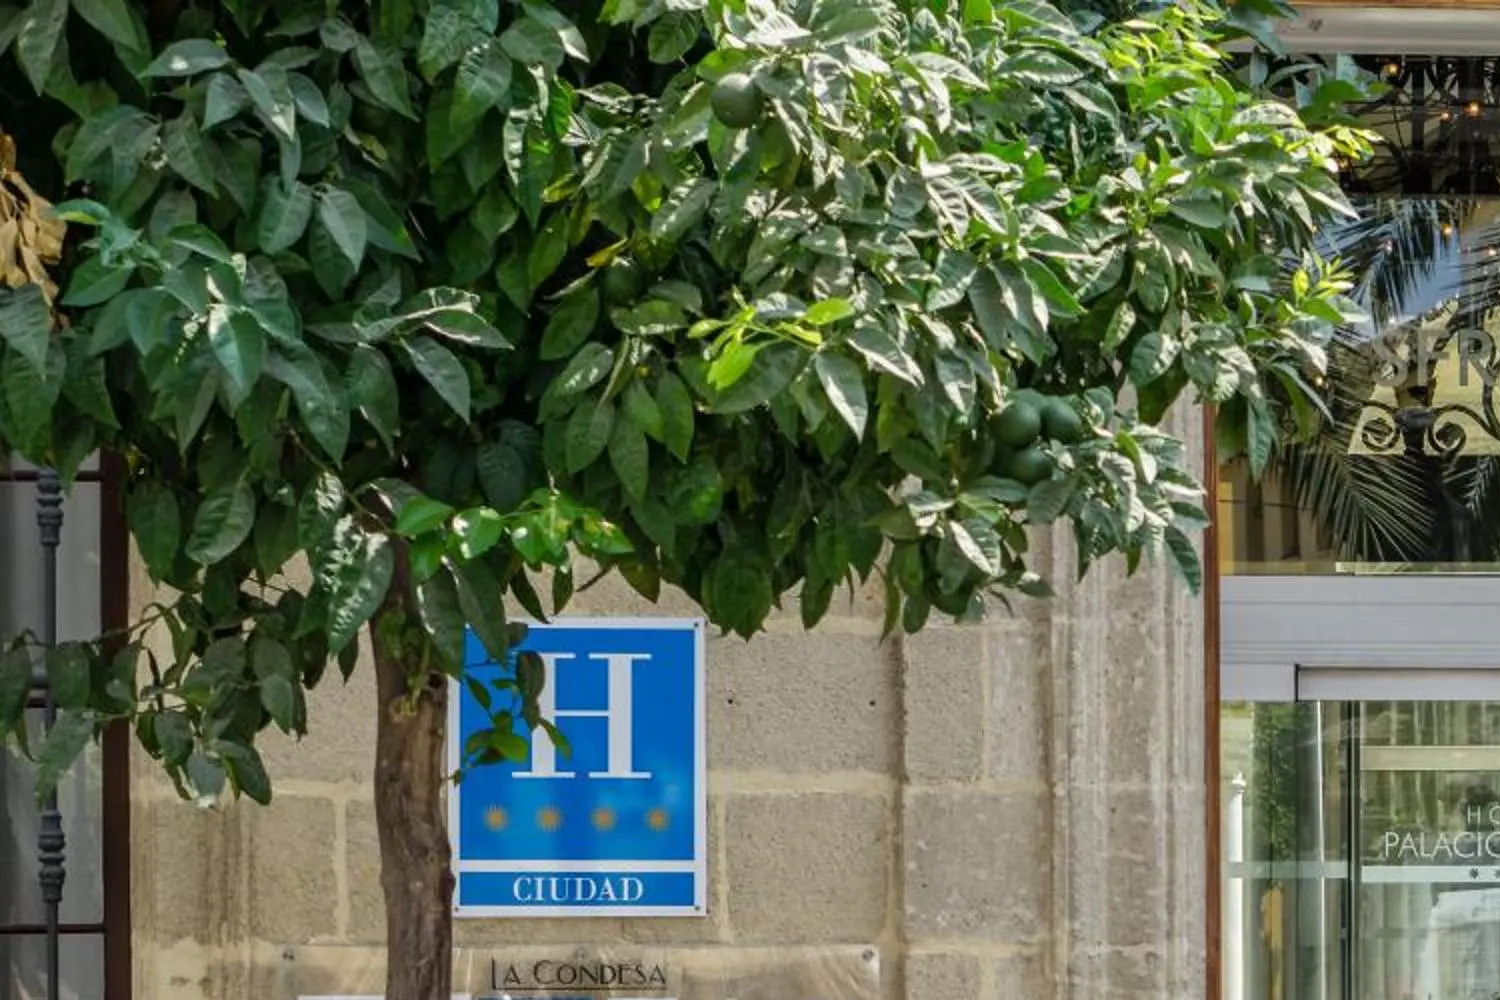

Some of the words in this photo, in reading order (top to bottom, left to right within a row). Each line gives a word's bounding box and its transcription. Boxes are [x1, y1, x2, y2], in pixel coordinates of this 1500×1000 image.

[511, 652, 652, 779] H
[512, 874, 644, 904] CIUDAD
[491, 957, 522, 990] LA
[533, 959, 668, 986] CONDESA
